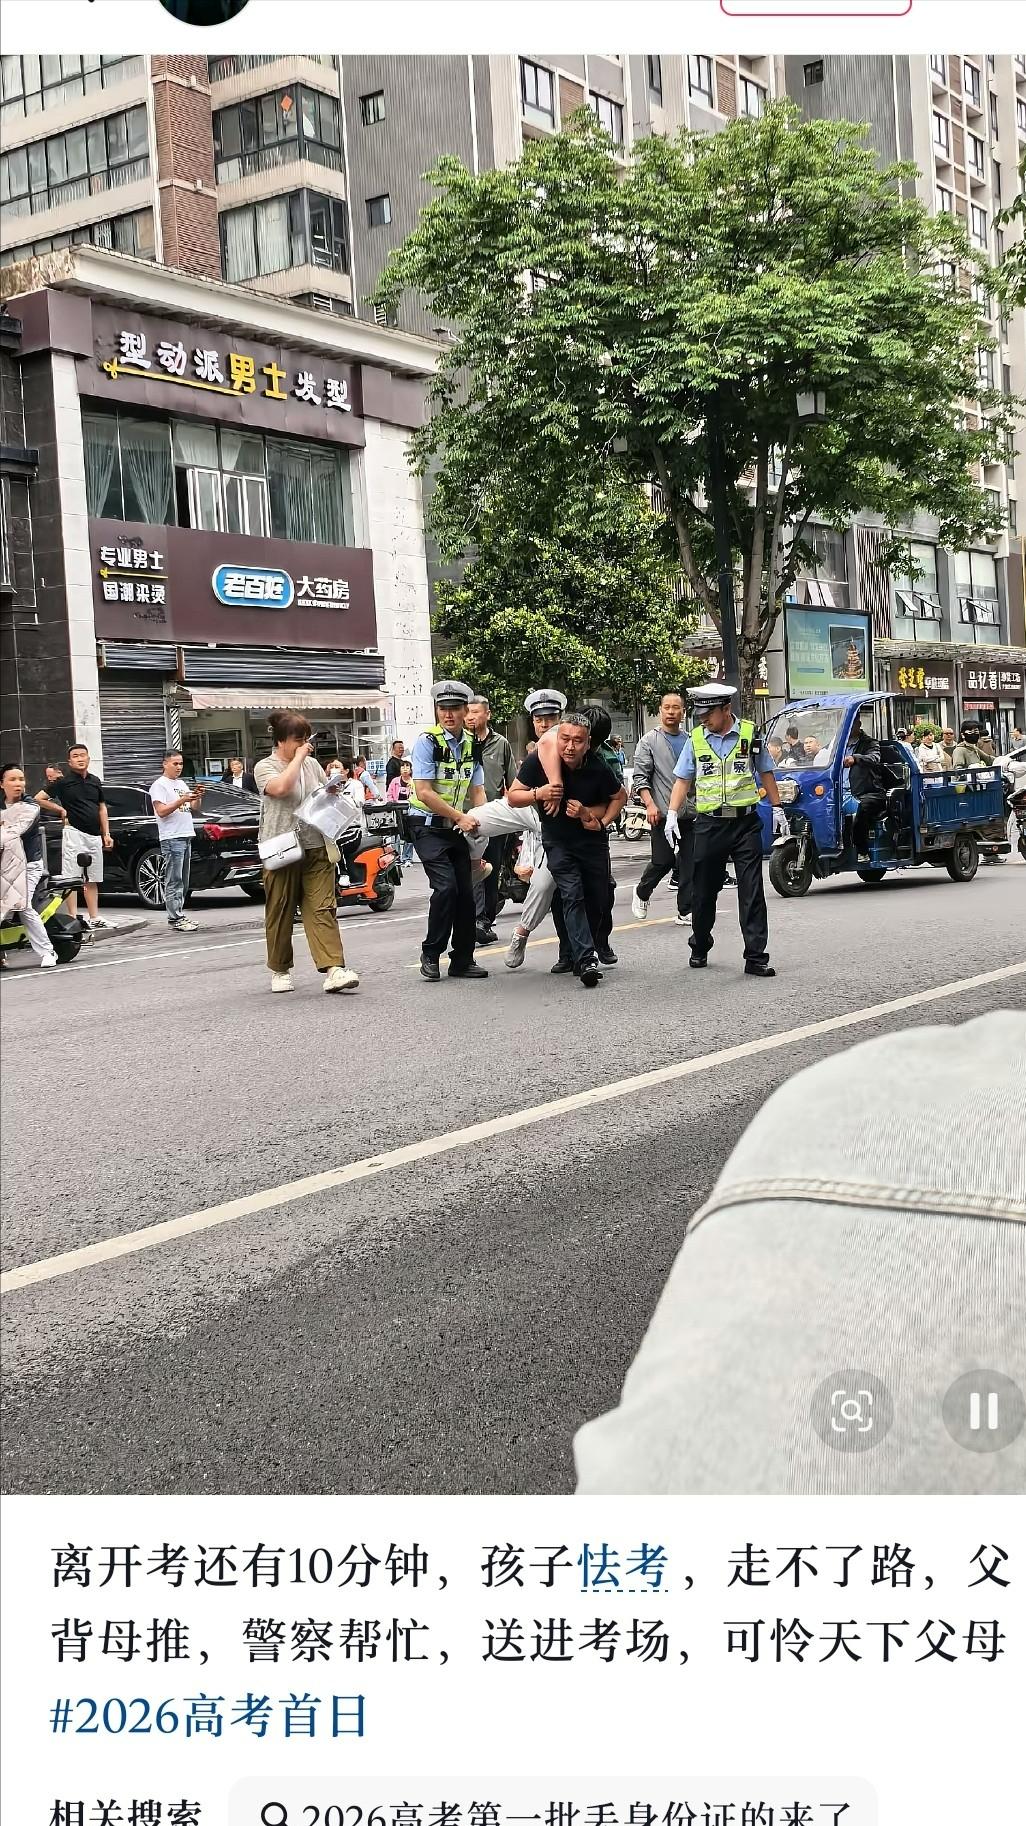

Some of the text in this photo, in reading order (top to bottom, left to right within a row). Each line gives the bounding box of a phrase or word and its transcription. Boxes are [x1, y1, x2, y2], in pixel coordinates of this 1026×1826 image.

[119, 330, 352, 412] 型动派男士发型
[100, 546, 164, 570] 专业男士
[102, 581, 166, 604] 国潮染烫
[296, 576, 350, 601] 大药房
[967, 670, 998, 690] 品忆香
